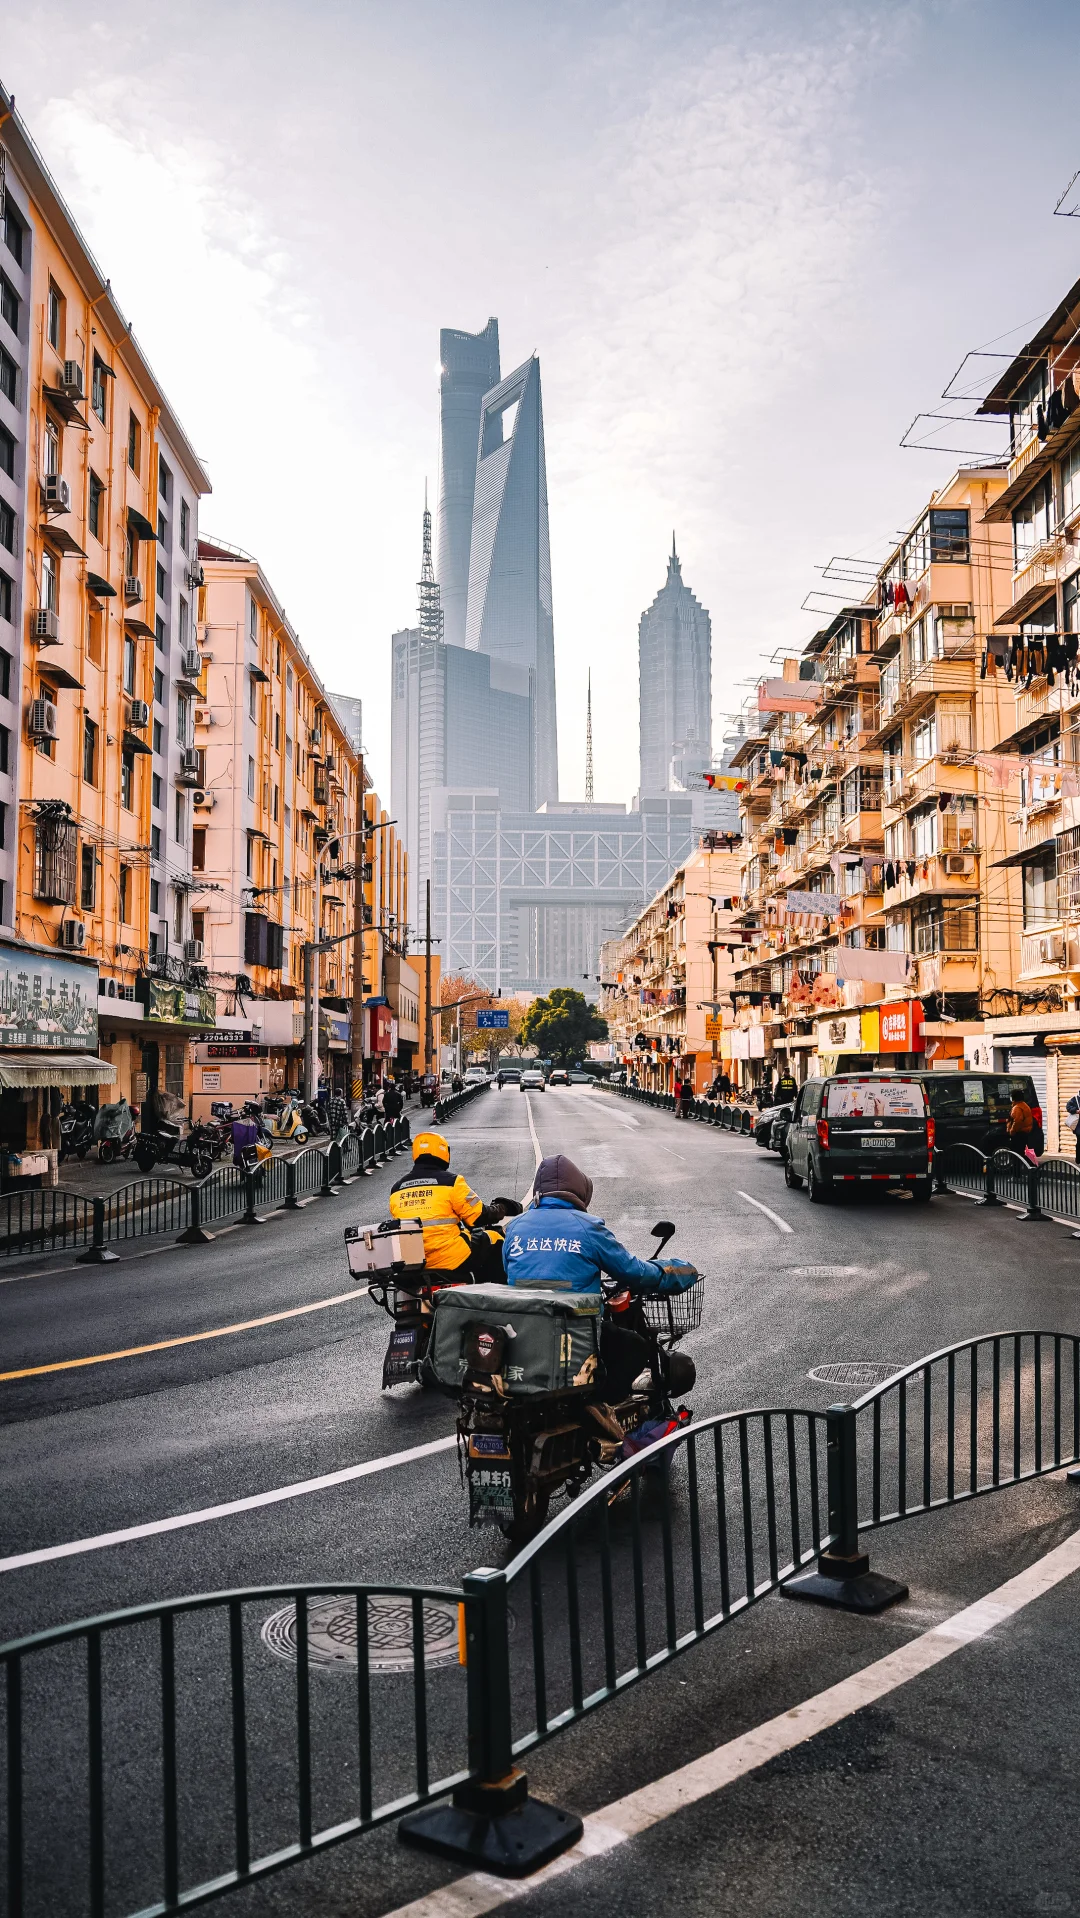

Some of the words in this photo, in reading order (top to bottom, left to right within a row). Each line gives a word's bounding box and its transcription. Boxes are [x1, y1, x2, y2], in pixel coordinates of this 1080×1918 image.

[527, 1237, 582, 1254] 达达快送
[476, 1442, 503, 1450] 6267032
[471, 1469, 512, 1487] 名牌车行
